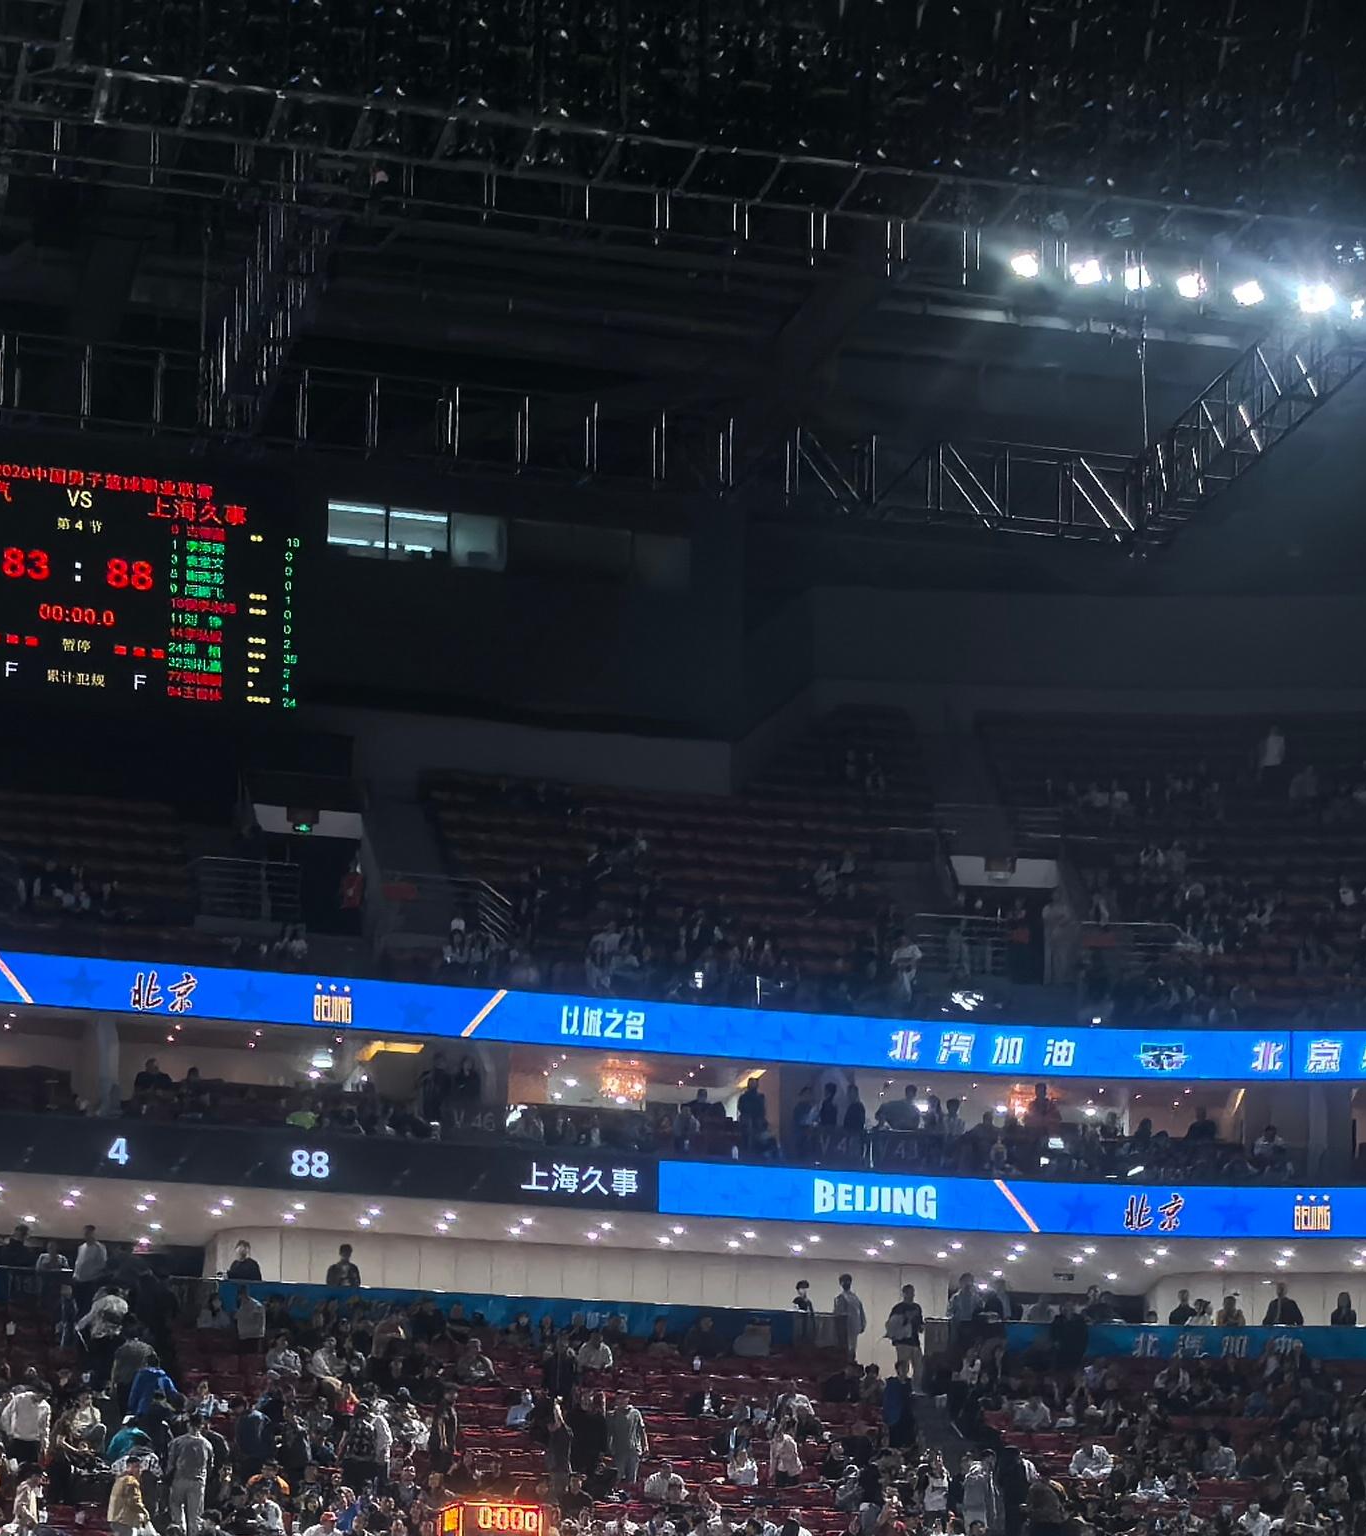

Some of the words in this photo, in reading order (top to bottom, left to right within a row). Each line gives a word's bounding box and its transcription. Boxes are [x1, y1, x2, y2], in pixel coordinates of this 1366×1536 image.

[67, 488, 93, 509] VS
[147, 497, 248, 526] 上海久事
[2, 547, 50, 580] 83
[107, 557, 154, 590] 88
[5, 660, 19, 678] F
[134, 673, 147, 691] F
[131, 970, 199, 1013] 北京
[313, 994, 353, 1025] BEIJING
[561, 1004, 646, 1040] 以城之名
[887, 1029, 1076, 1068] 北汽加油
[108, 1135, 129, 1166] 4
[290, 1149, 331, 1180] 88
[520, 1162, 640, 1198] 上海久事
[813, 1177, 937, 1220] BEIJING
[1122, 1193, 1185, 1233] 北京
[1293, 1203, 1331, 1232] BEIJING
